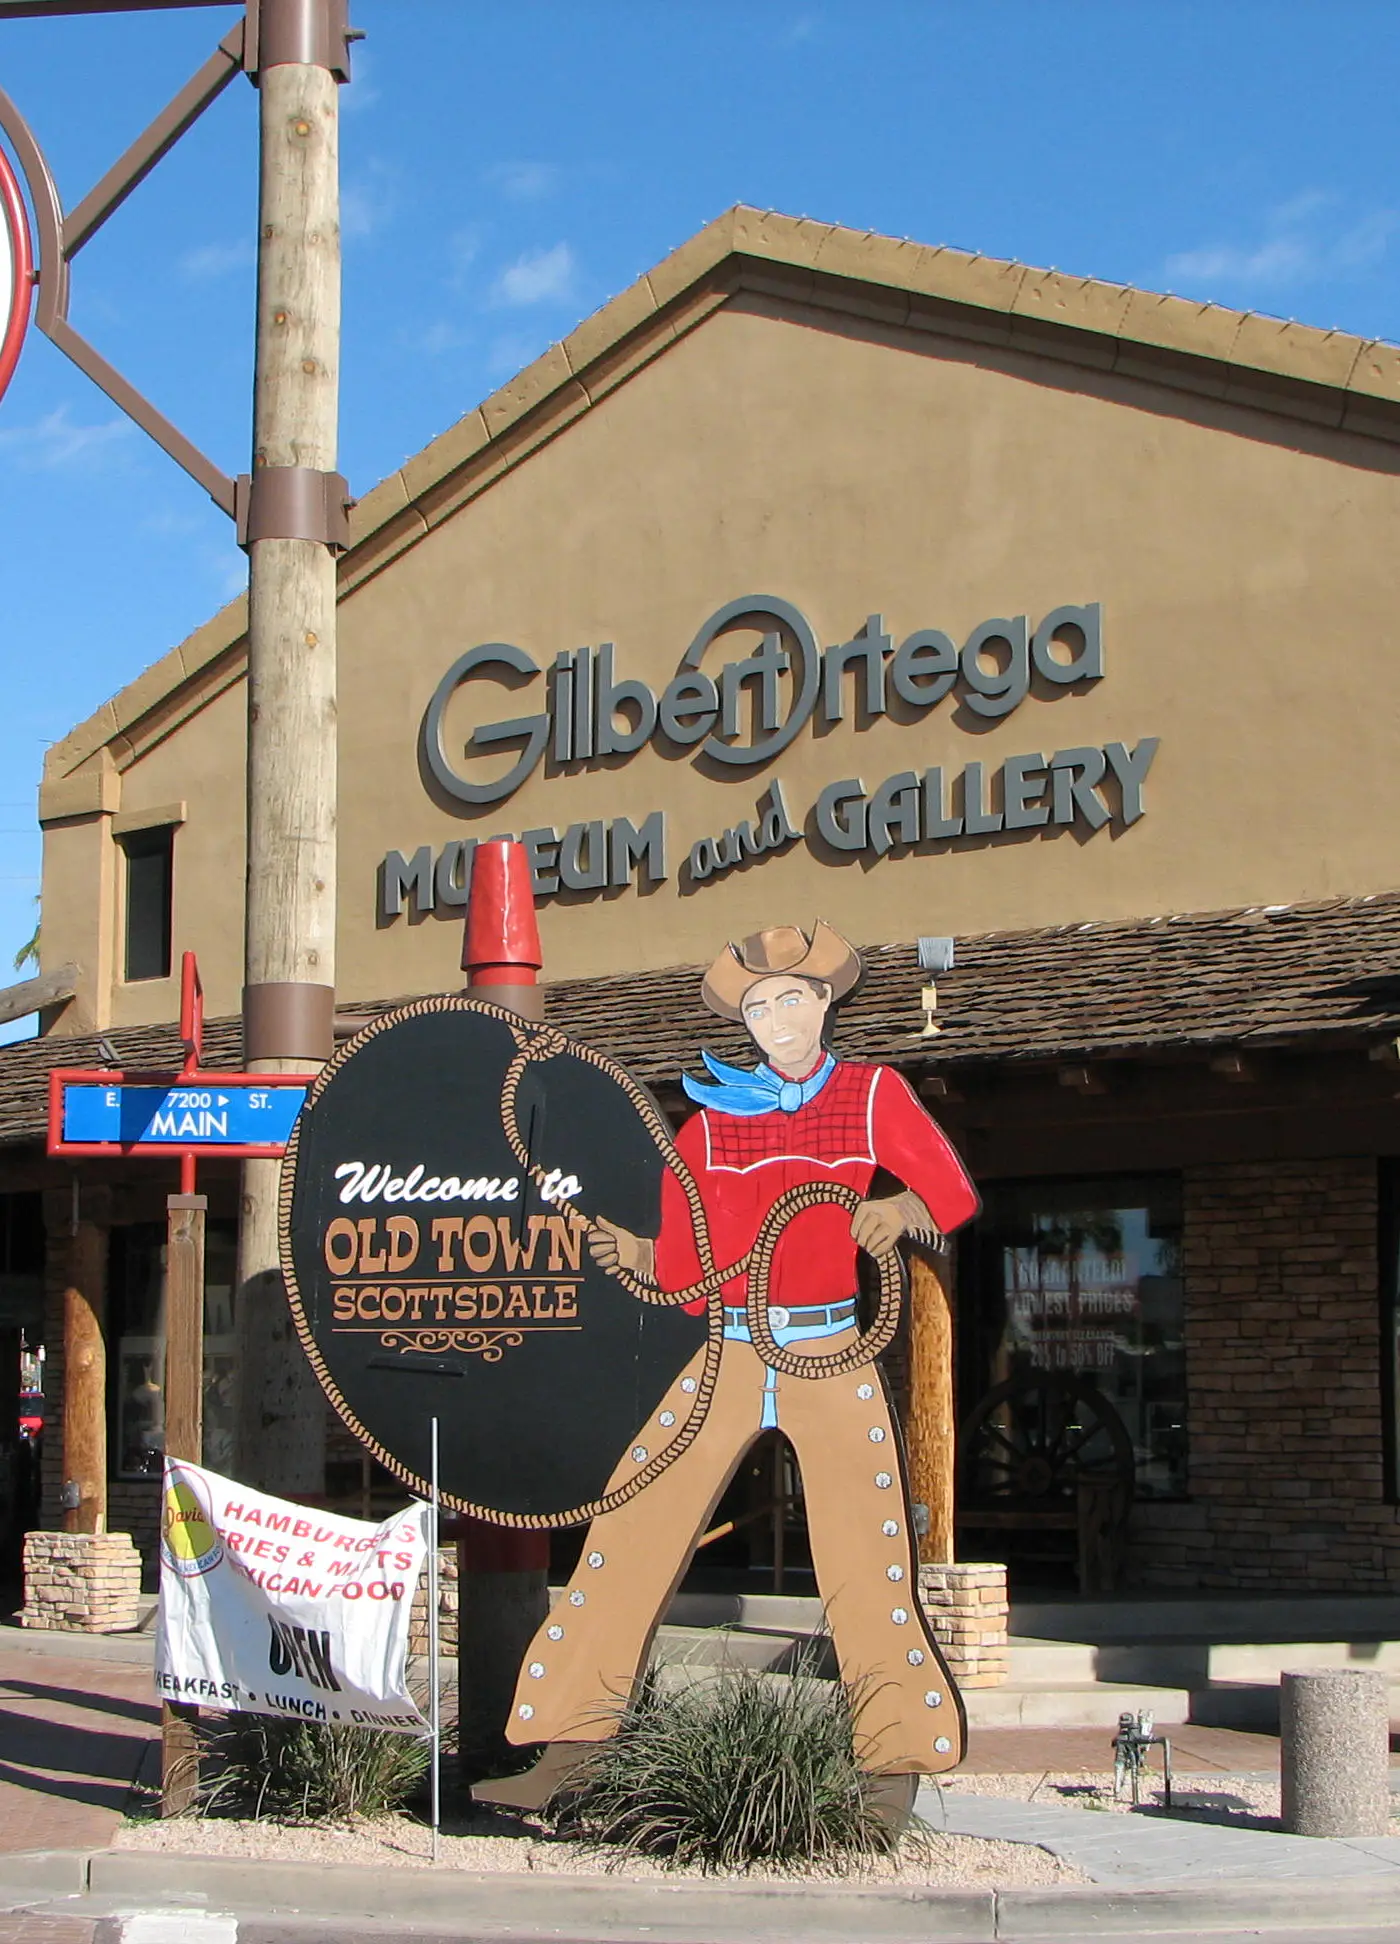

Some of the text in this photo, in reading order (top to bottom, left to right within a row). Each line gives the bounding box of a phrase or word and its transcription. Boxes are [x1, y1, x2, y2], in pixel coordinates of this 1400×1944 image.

[425, 594, 1107, 803] Gilbert Ortega
[385, 737, 1160, 914] MUEUM and GALLERY
[105, 1092, 272, 1109] E. 7200 ST.
[151, 1111, 228, 1137] MAIN
[334, 1161, 583, 1204] Welcome to
[325, 1214, 586, 1275] OLD TOWN
[333, 1285, 578, 1320] SCOTTSDALE
[1078, 1291, 1134, 1314] PRICES
[1097, 1342, 1115, 1365] OFF
[228, 1556, 405, 1601] XICAN FOOD
[297, 1550, 315, 1567] &
[327, 1550, 413, 1577] MTS
[268, 1613, 342, 1692] OPEN
[155, 1671, 424, 1727] REAKFAST LUNCH DINNER
